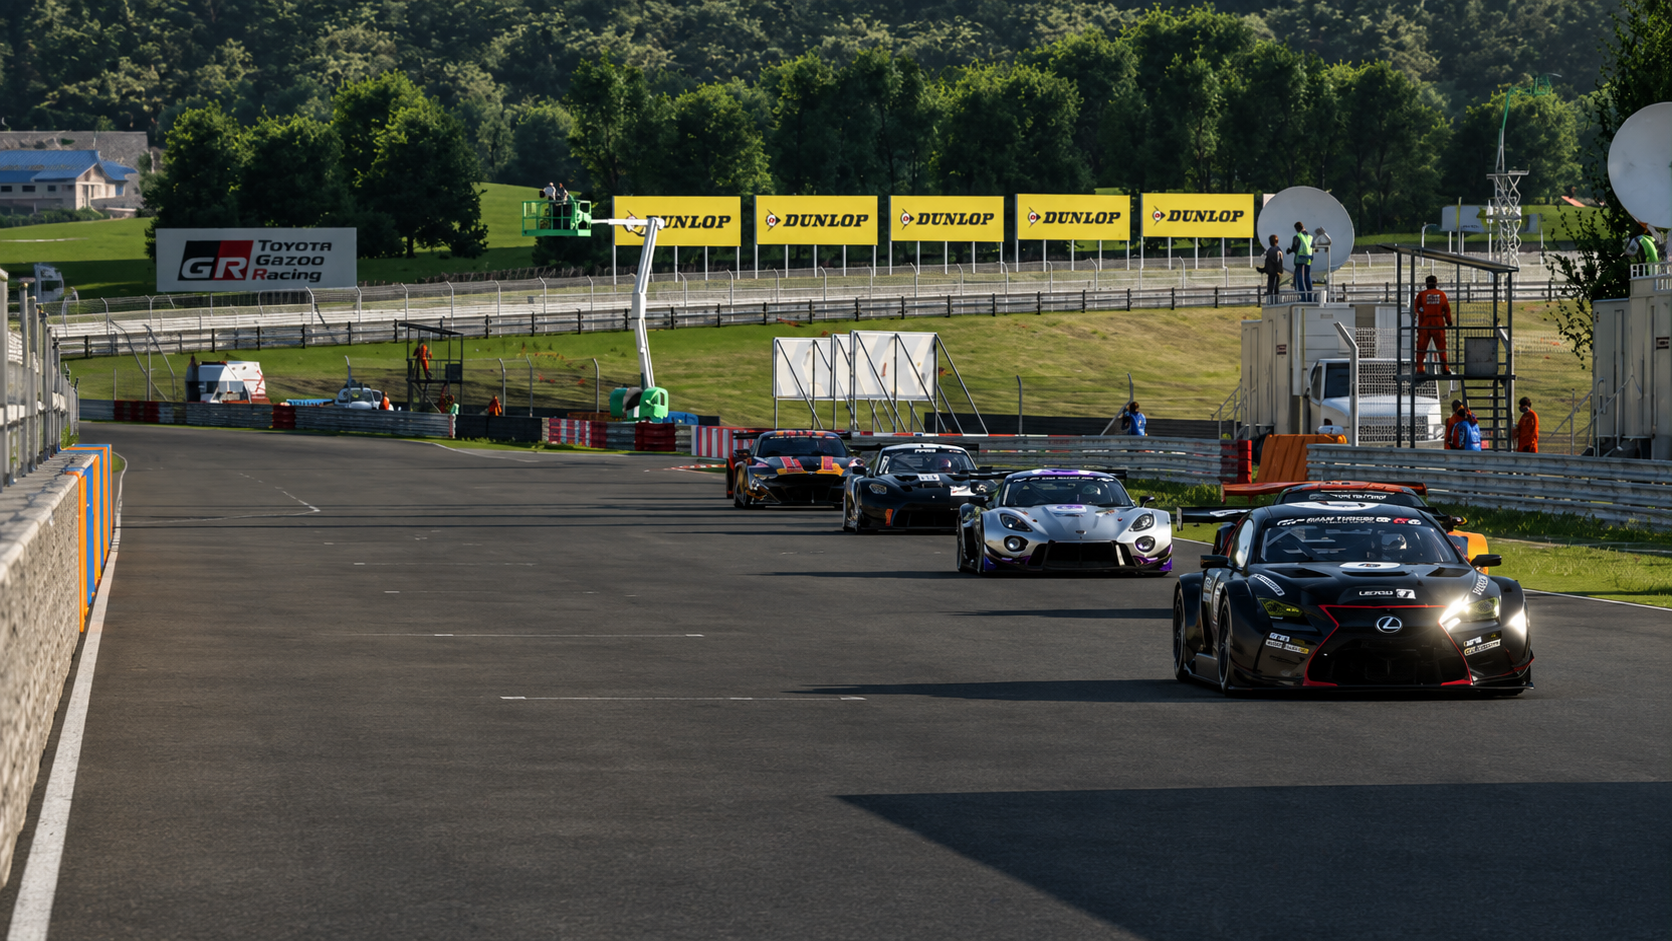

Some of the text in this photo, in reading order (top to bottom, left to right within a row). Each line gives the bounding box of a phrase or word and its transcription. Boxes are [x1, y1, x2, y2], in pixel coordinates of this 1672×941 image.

[783, 214, 869, 228] DUNLOP
[916, 213, 995, 226] DUNLOP
[1043, 211, 1121, 225] DUNLOP
[1166, 210, 1245, 223] DUNLOP
[258, 239, 332, 252] TOYOTA
[255, 254, 325, 267] Gazoo
[181, 257, 248, 279] GR
[252, 268, 322, 283] Racing
